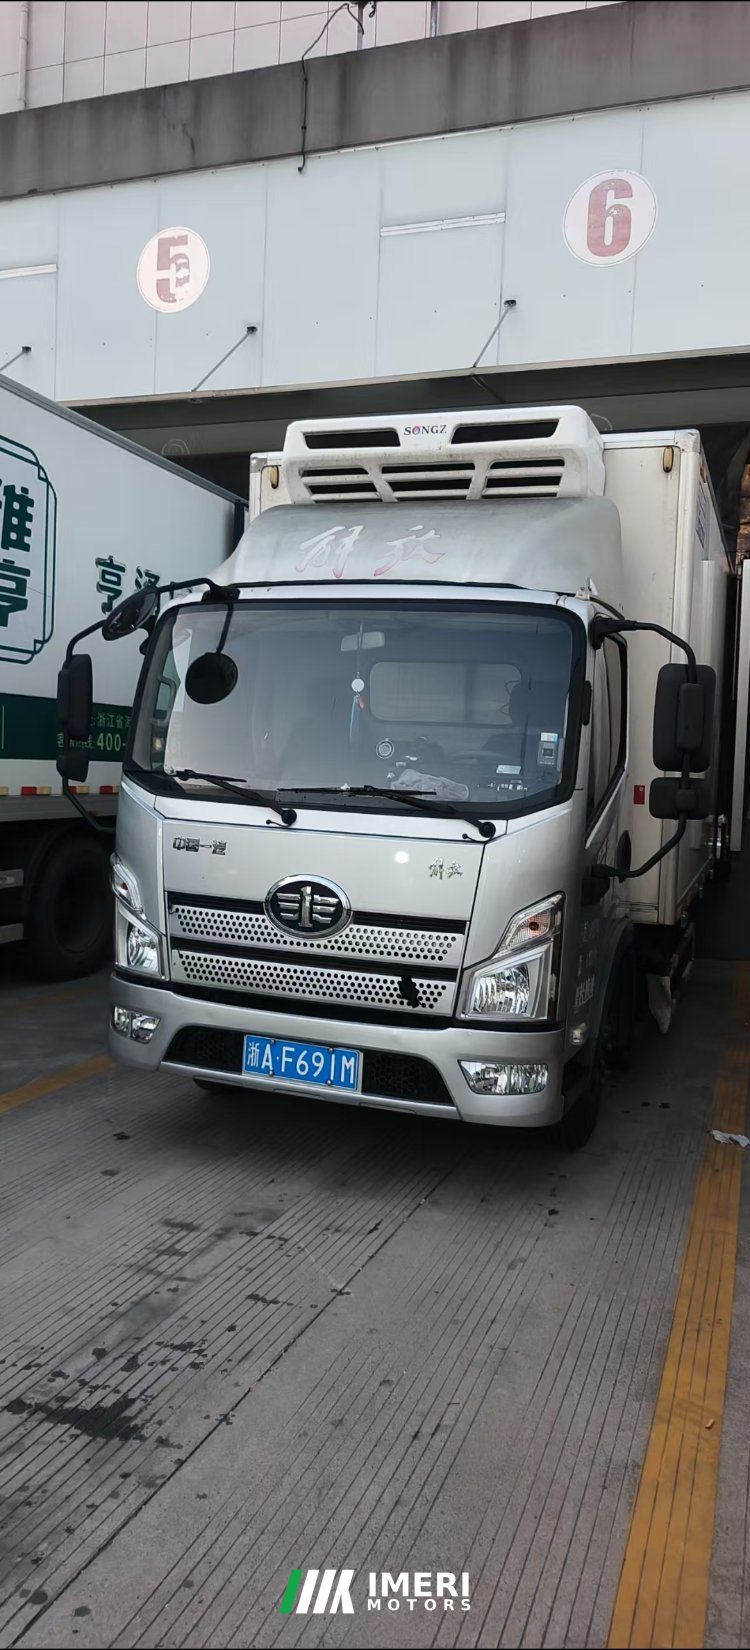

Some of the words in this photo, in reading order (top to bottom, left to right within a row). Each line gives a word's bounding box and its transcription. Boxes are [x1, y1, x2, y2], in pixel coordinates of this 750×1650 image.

[586, 177, 633, 258] 6
[156, 233, 191, 304] 5
[403, 424, 448, 436] SONGZ
